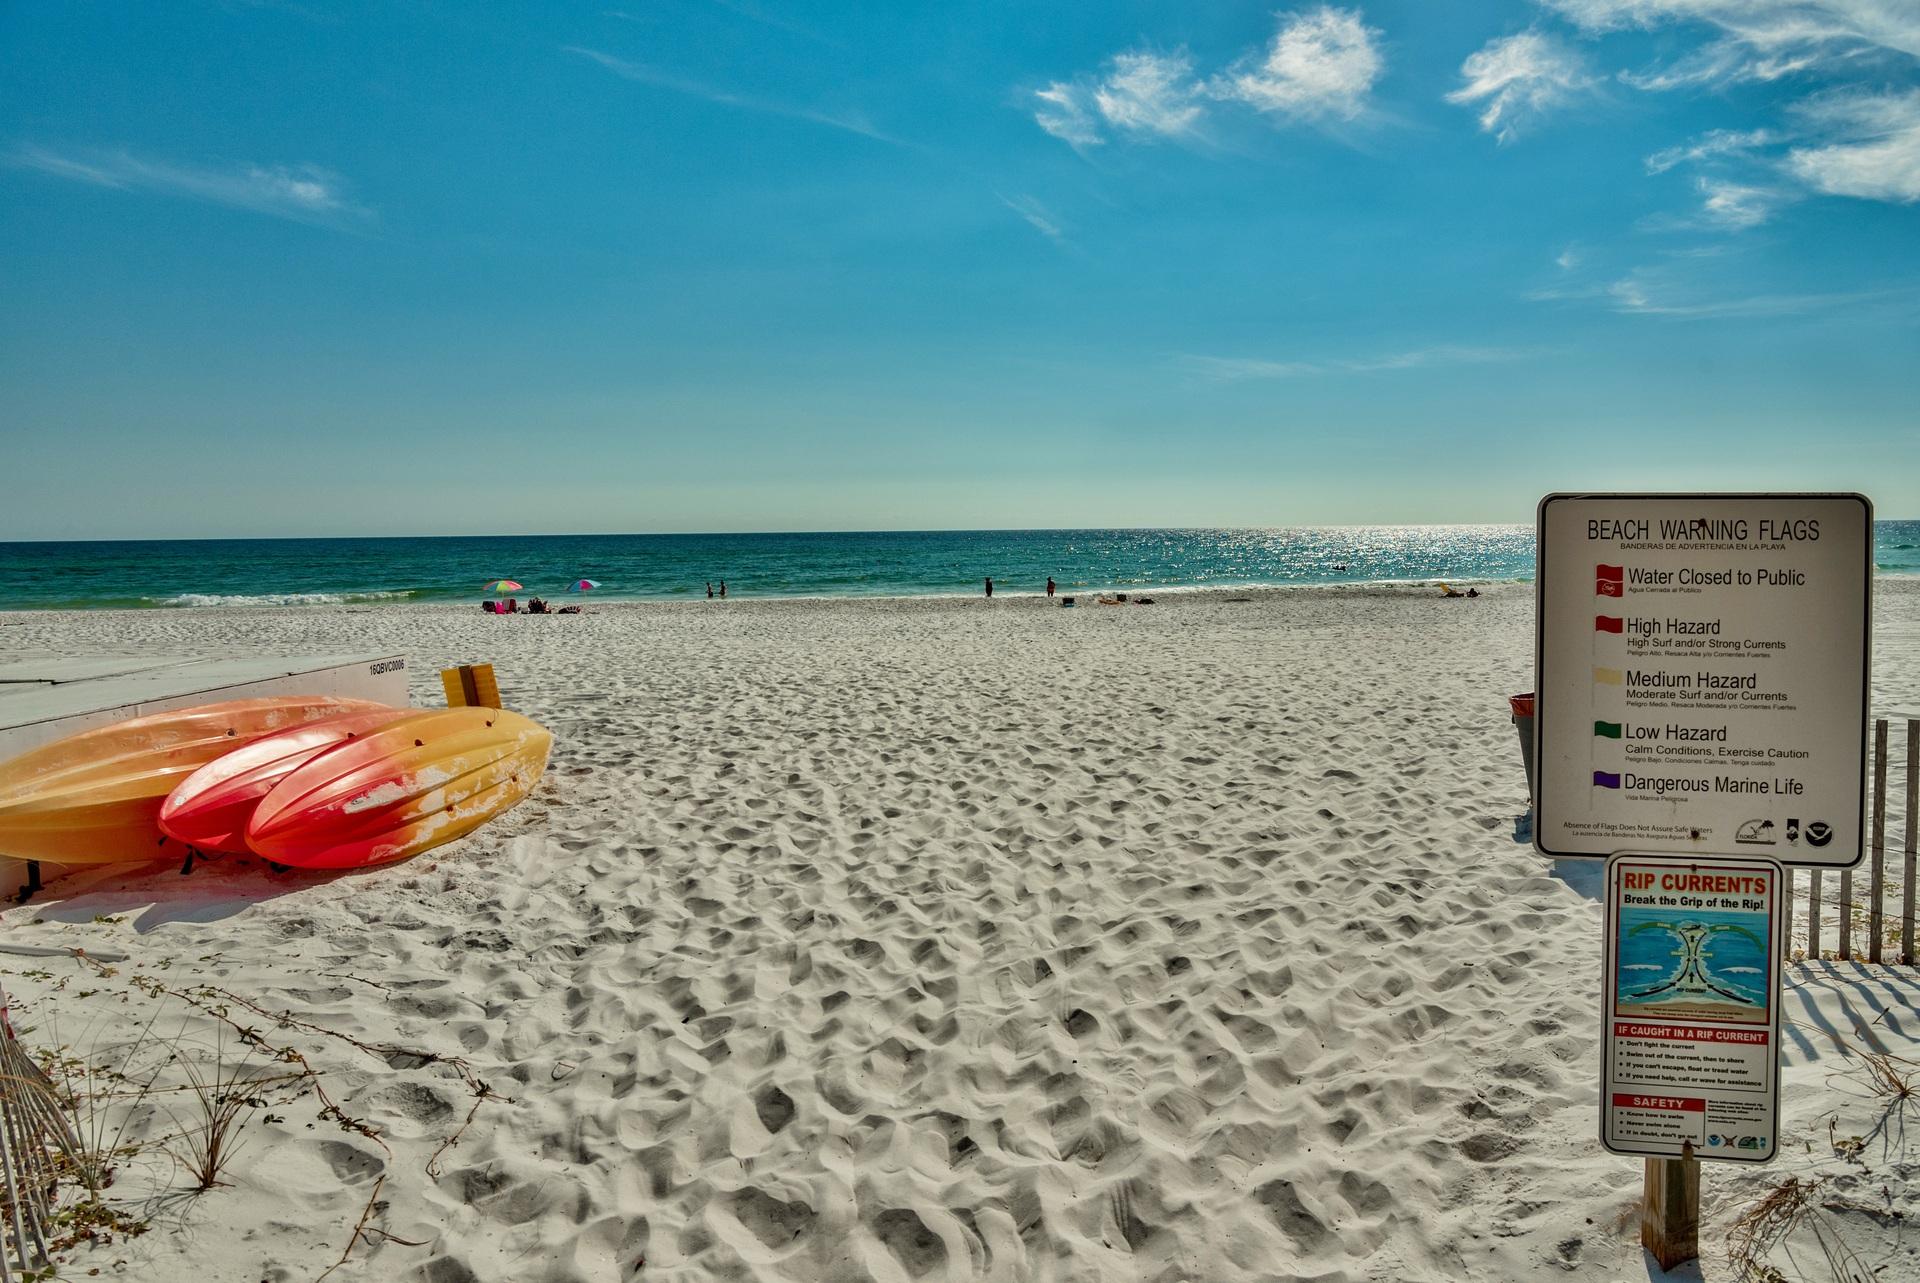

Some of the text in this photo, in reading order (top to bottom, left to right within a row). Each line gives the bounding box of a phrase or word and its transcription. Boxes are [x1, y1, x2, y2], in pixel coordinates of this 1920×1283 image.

[1588, 520, 1820, 540] BEACH WARNING FLAGS
[1628, 568, 1805, 585] Water Closed to Public
[1628, 618, 1720, 637] High Hazard
[1628, 638, 1786, 650] High Surf and/or Strong Currents
[1627, 670, 1756, 689] Medium Hazard
[1626, 689, 1788, 701] Moderate Surf and/or Currents
[1626, 723, 1726, 741] Low Hazard
[1626, 744, 1809, 758] Calm Conditions, Exercise Caution
[1625, 773, 1803, 795] Dangerous Marine Life
[1625, 873, 1766, 894] RIP CURRENTS
[1624, 894, 1764, 911] Break the Grip of the Rip!
[1631, 1026, 1671, 1036] CAUGHT
[1674, 1029, 1684, 1037] IN
[1697, 1030, 1713, 1039] RIP
[1716, 1031, 1764, 1041] CURRENT
[1633, 1097, 1684, 1108] SAFETY
